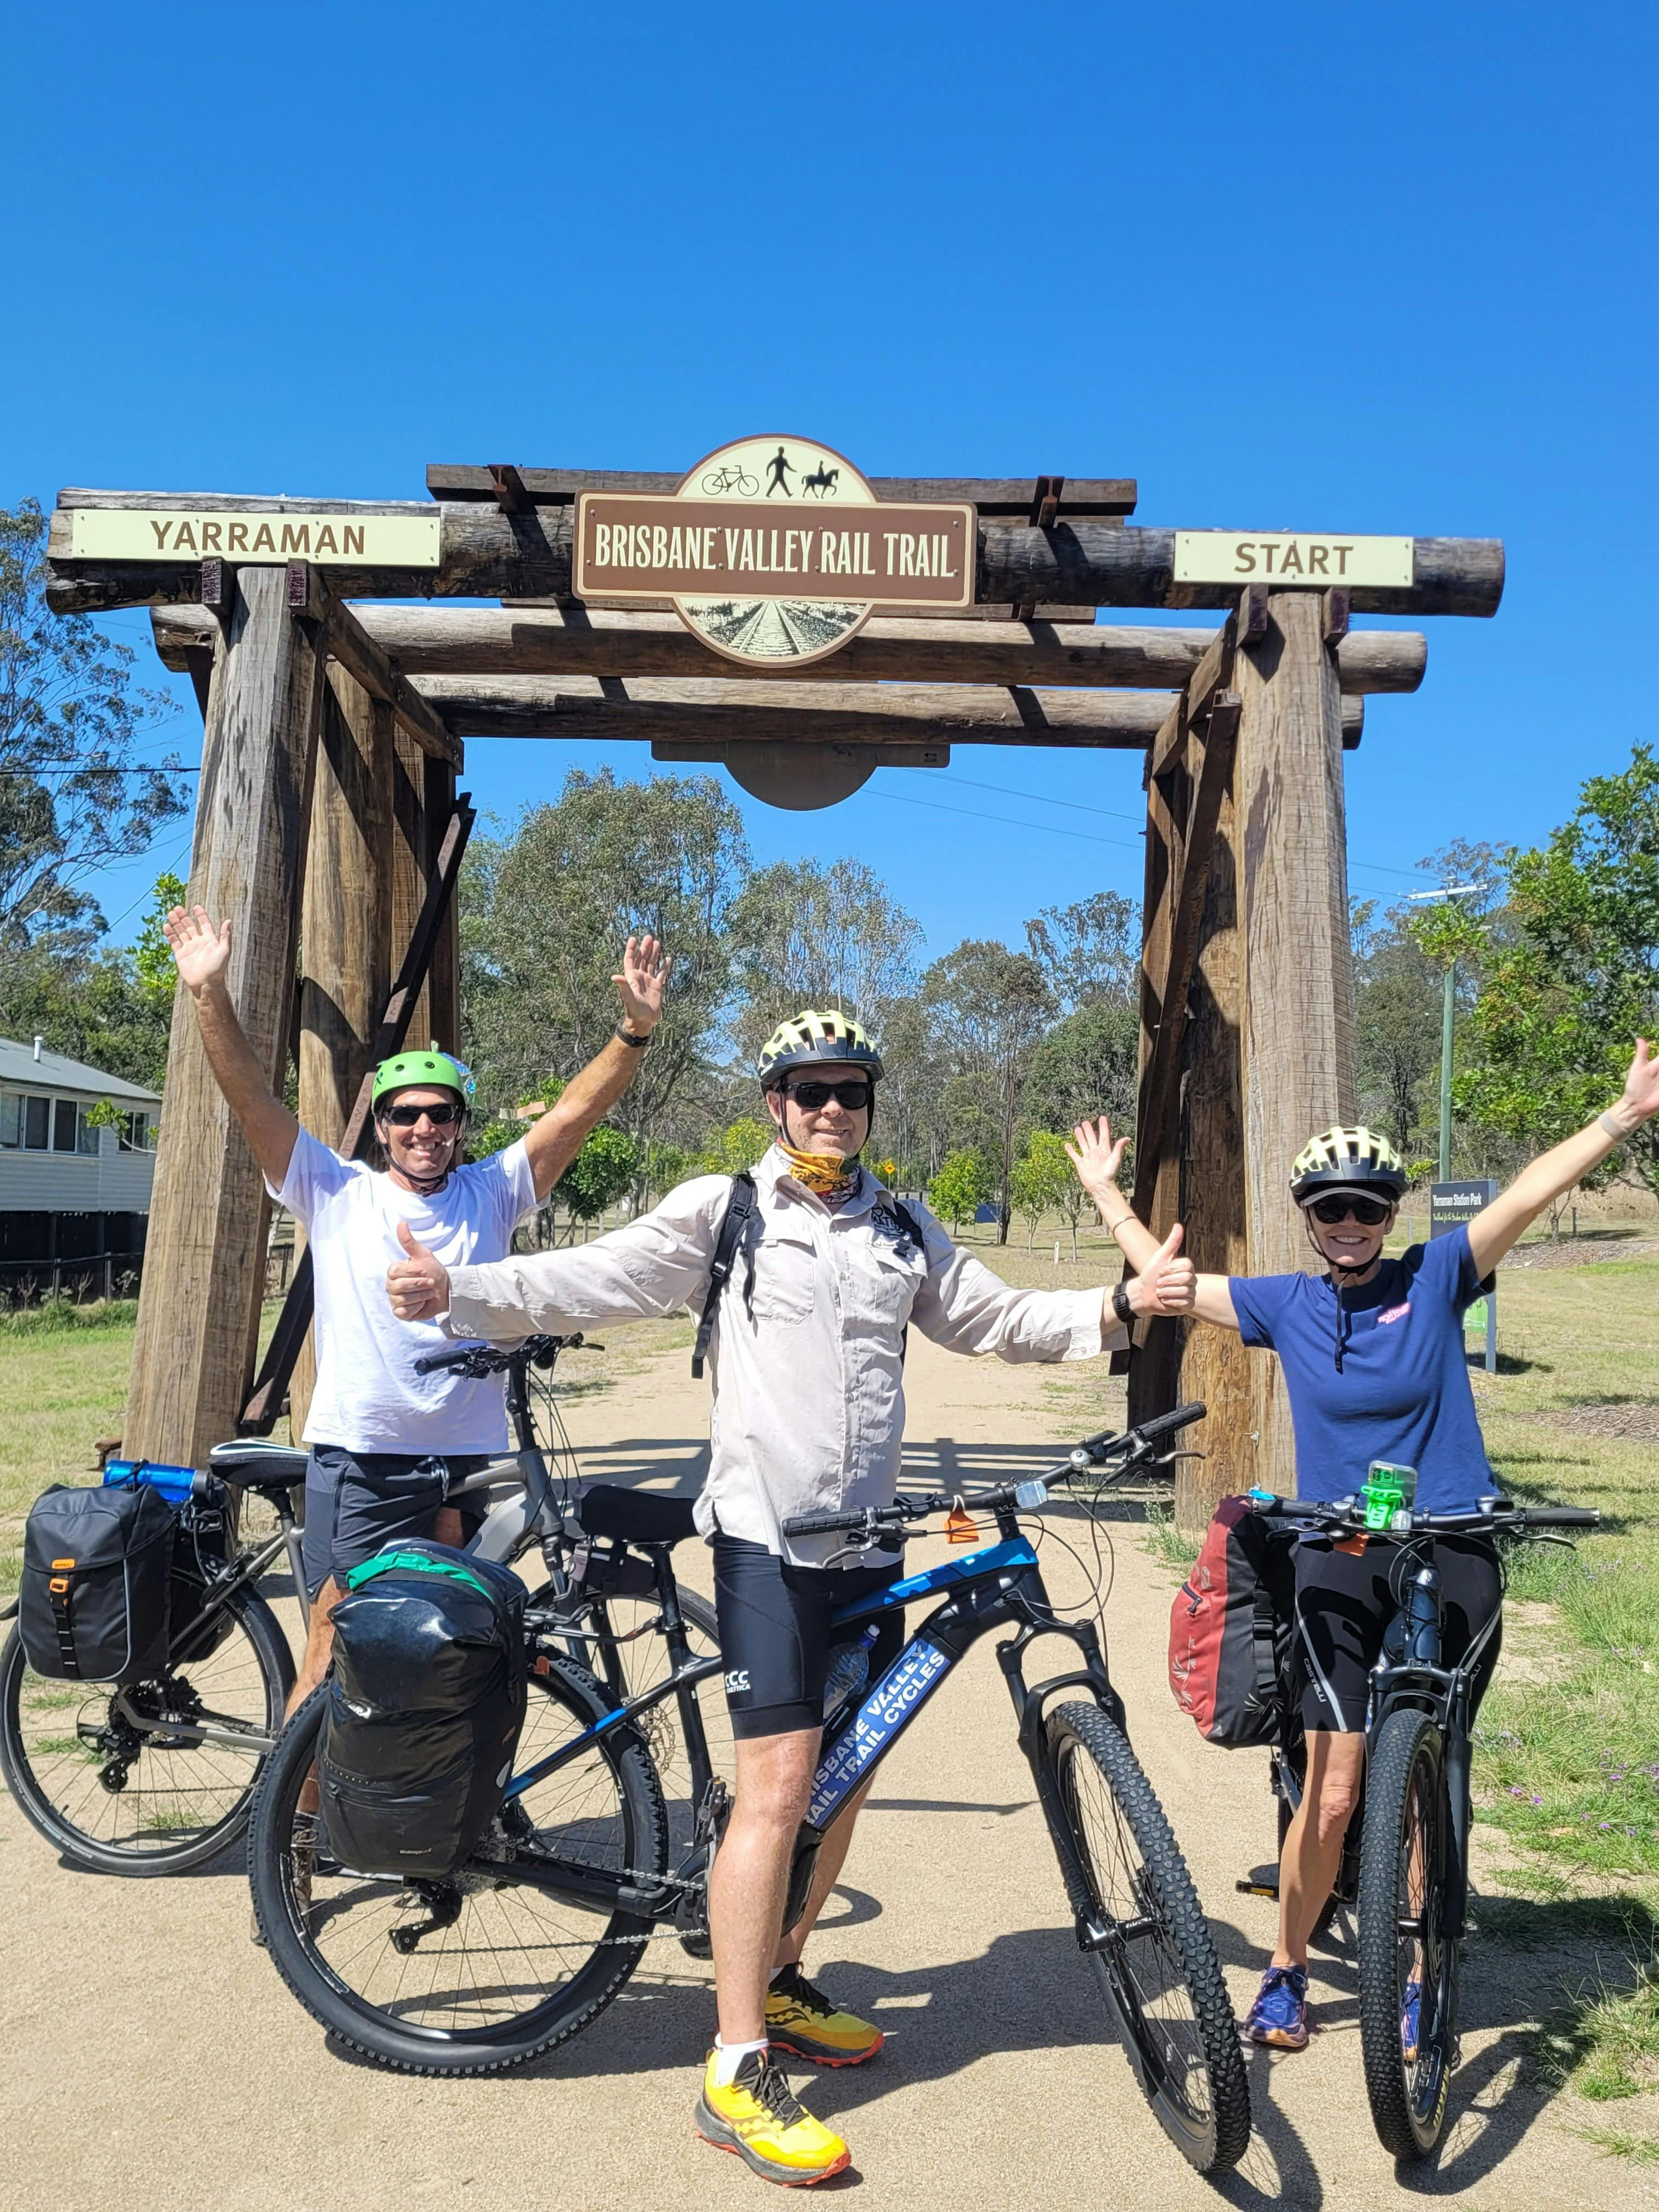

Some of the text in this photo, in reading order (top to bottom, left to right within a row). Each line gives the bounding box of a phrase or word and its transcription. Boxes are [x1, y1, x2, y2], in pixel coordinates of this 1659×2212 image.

[150, 521, 364, 555] YARRAMAN
[595, 524, 954, 577] BRISBANE VALLEY RAIL TRAIL
[1234, 542, 1354, 575] START
[1453, 1193, 1470, 1206] Station
[1470, 1192, 1482, 1206] Park
[809, 1644, 927, 1797] ISBANE VALLEY
[834, 1729, 887, 1782] TRAIL
[883, 1651, 945, 1724] CYCLES
